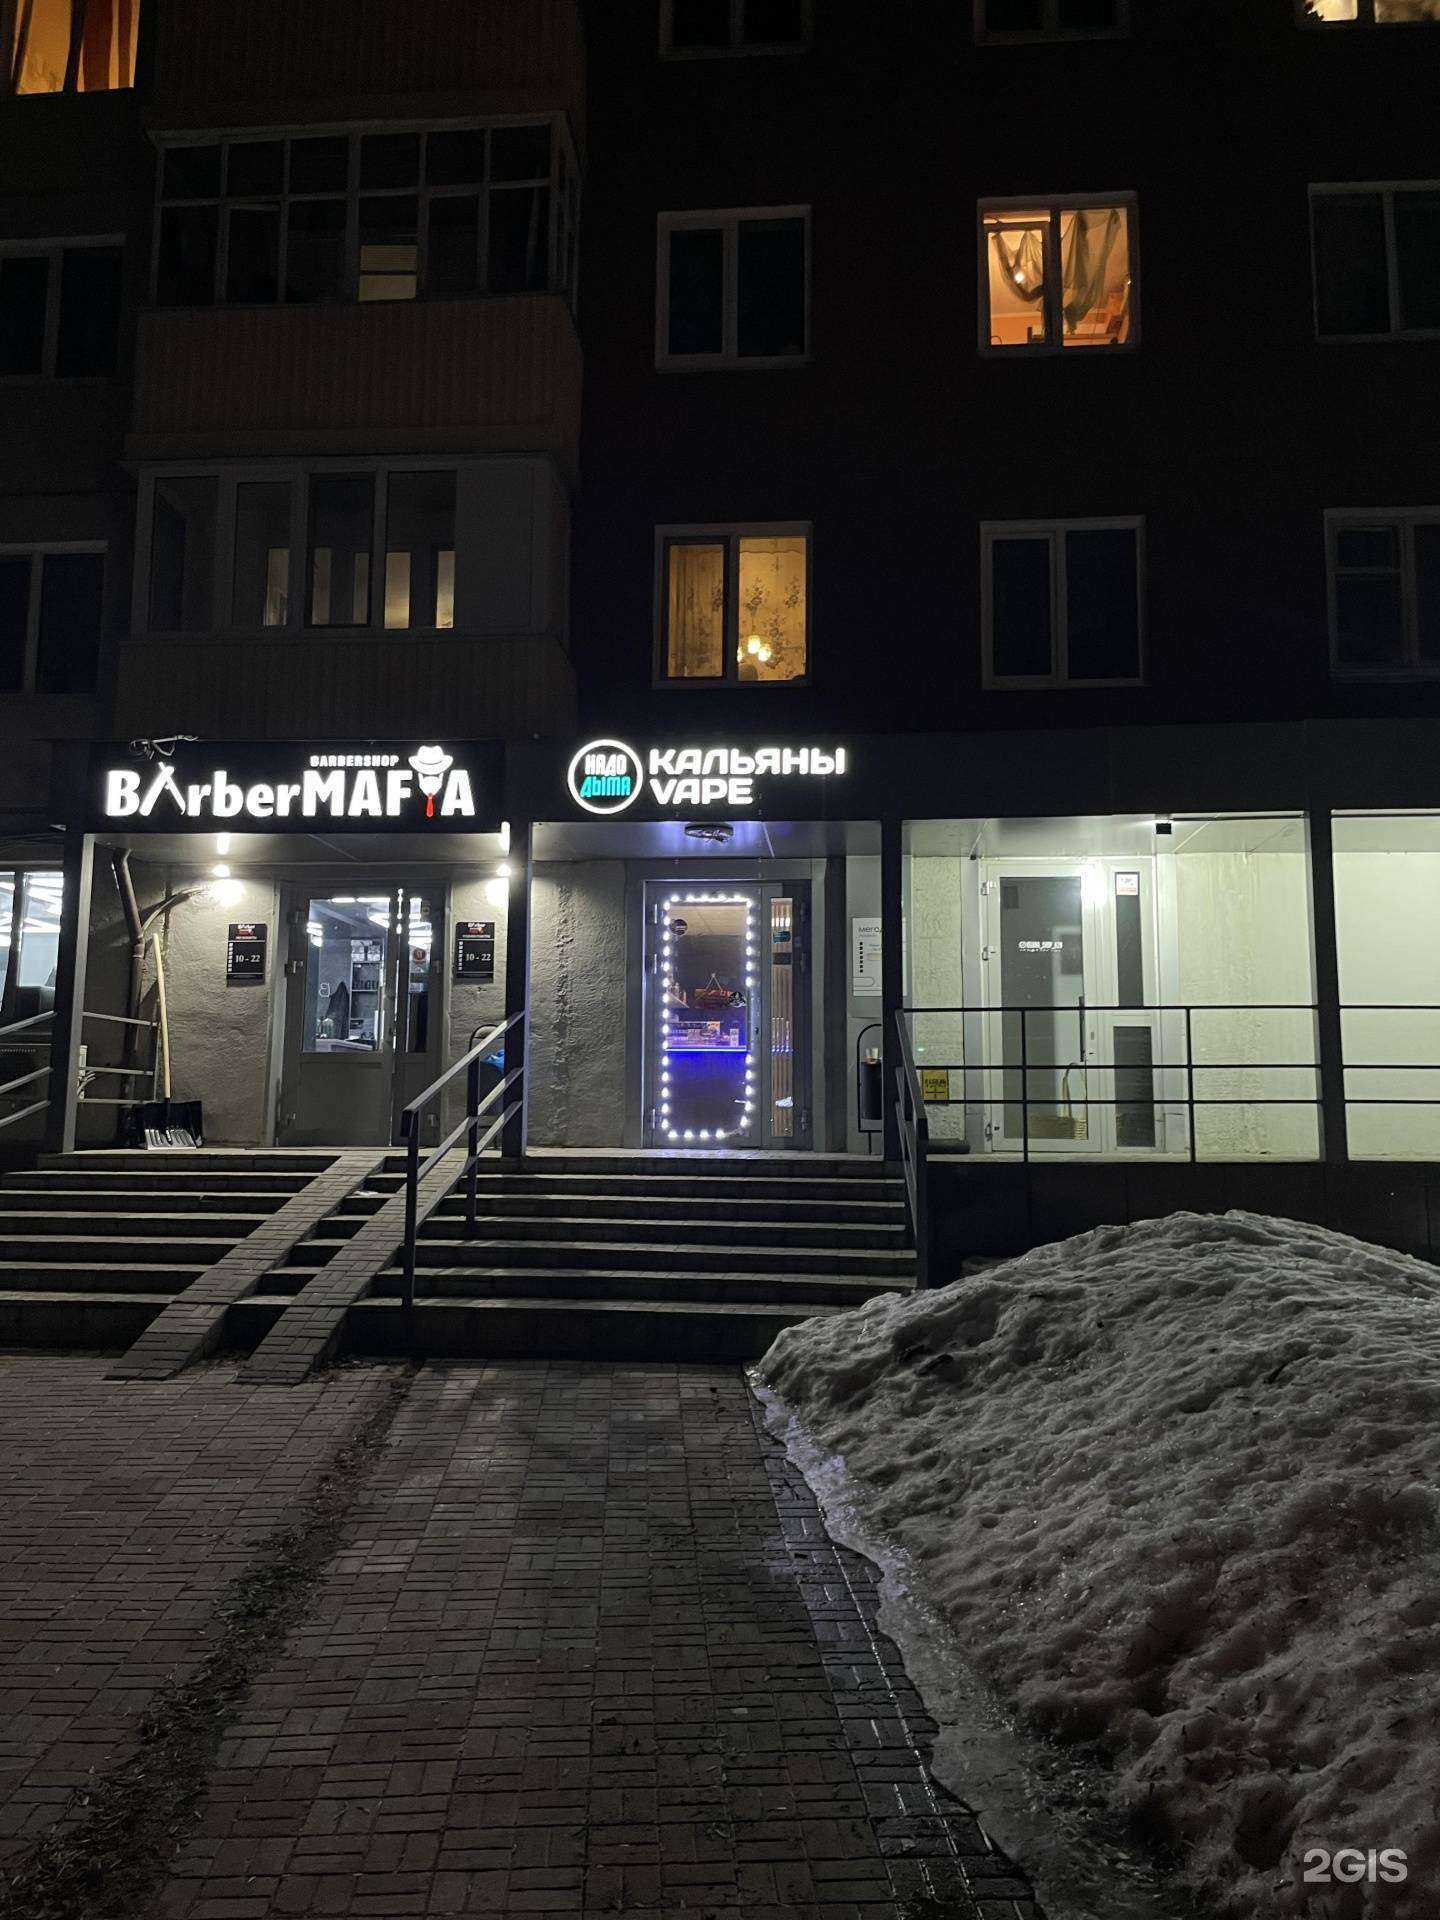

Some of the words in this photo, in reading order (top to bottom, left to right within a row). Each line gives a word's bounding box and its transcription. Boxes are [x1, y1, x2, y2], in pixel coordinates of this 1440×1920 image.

[309, 754, 400, 767] BARBERSHOP
[648, 747, 846, 775] КАЛЬЯНЫ
[649, 777, 754, 805] VAPE
[235, 955, 244, 963] 10
[466, 953, 475, 961] 10
[481, 953, 491, 961] 22
